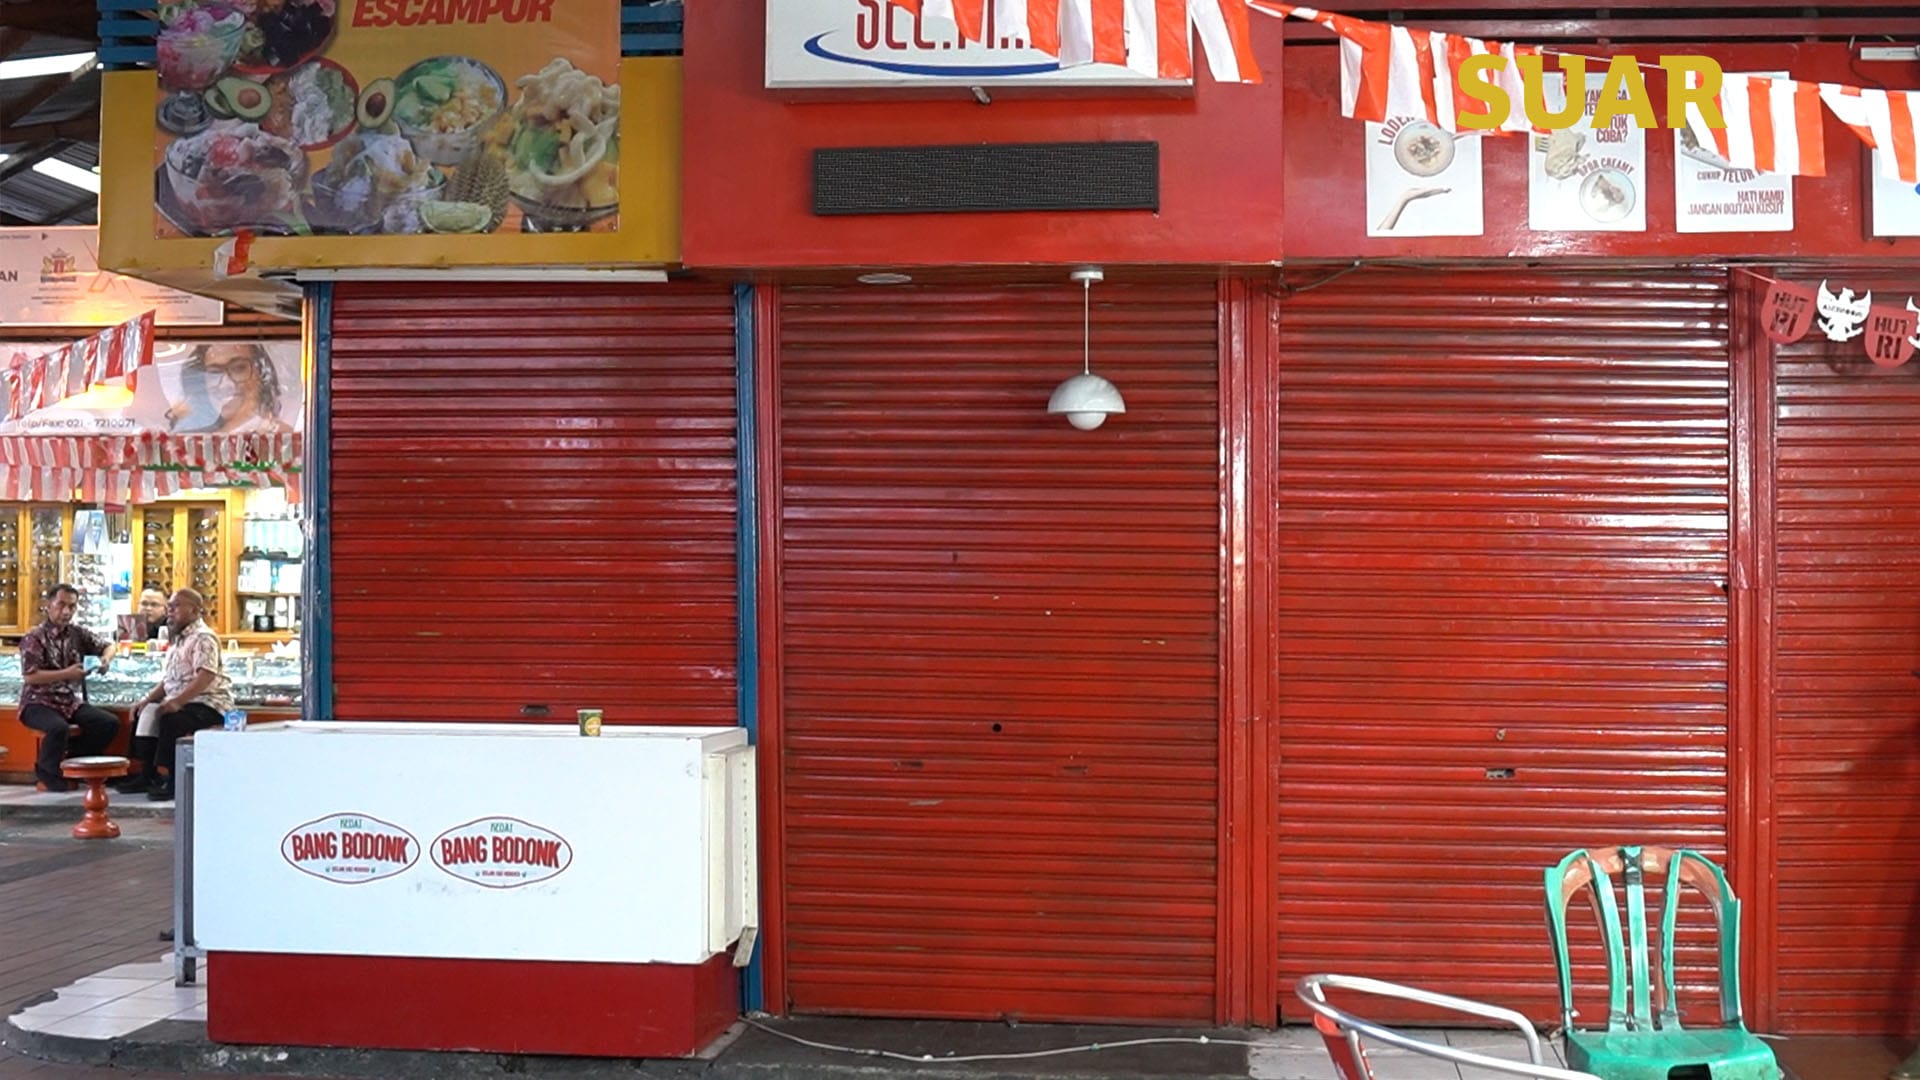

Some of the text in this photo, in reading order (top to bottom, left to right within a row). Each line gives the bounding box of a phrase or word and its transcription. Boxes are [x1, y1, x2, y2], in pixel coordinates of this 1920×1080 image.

[352, 0, 553, 28] ESCAMPUR
[1596, 129, 1628, 143] COBA?
[1601, 157, 1635, 175] CREAMY
[1722, 168, 1755, 183] TELUR
[1737, 189, 1785, 203] HATI KAMU
[1687, 201, 1784, 215] JANGAN IKUTAN KUSUT
[1772, 292, 1809, 313] HUT
[1769, 309, 1799, 337] RI
[1874, 316, 1908, 335] HUT
[1875, 335, 1902, 360] RI
[291, 831, 410, 865] BANG BODONK
[441, 835, 563, 869] BANG BODONK
